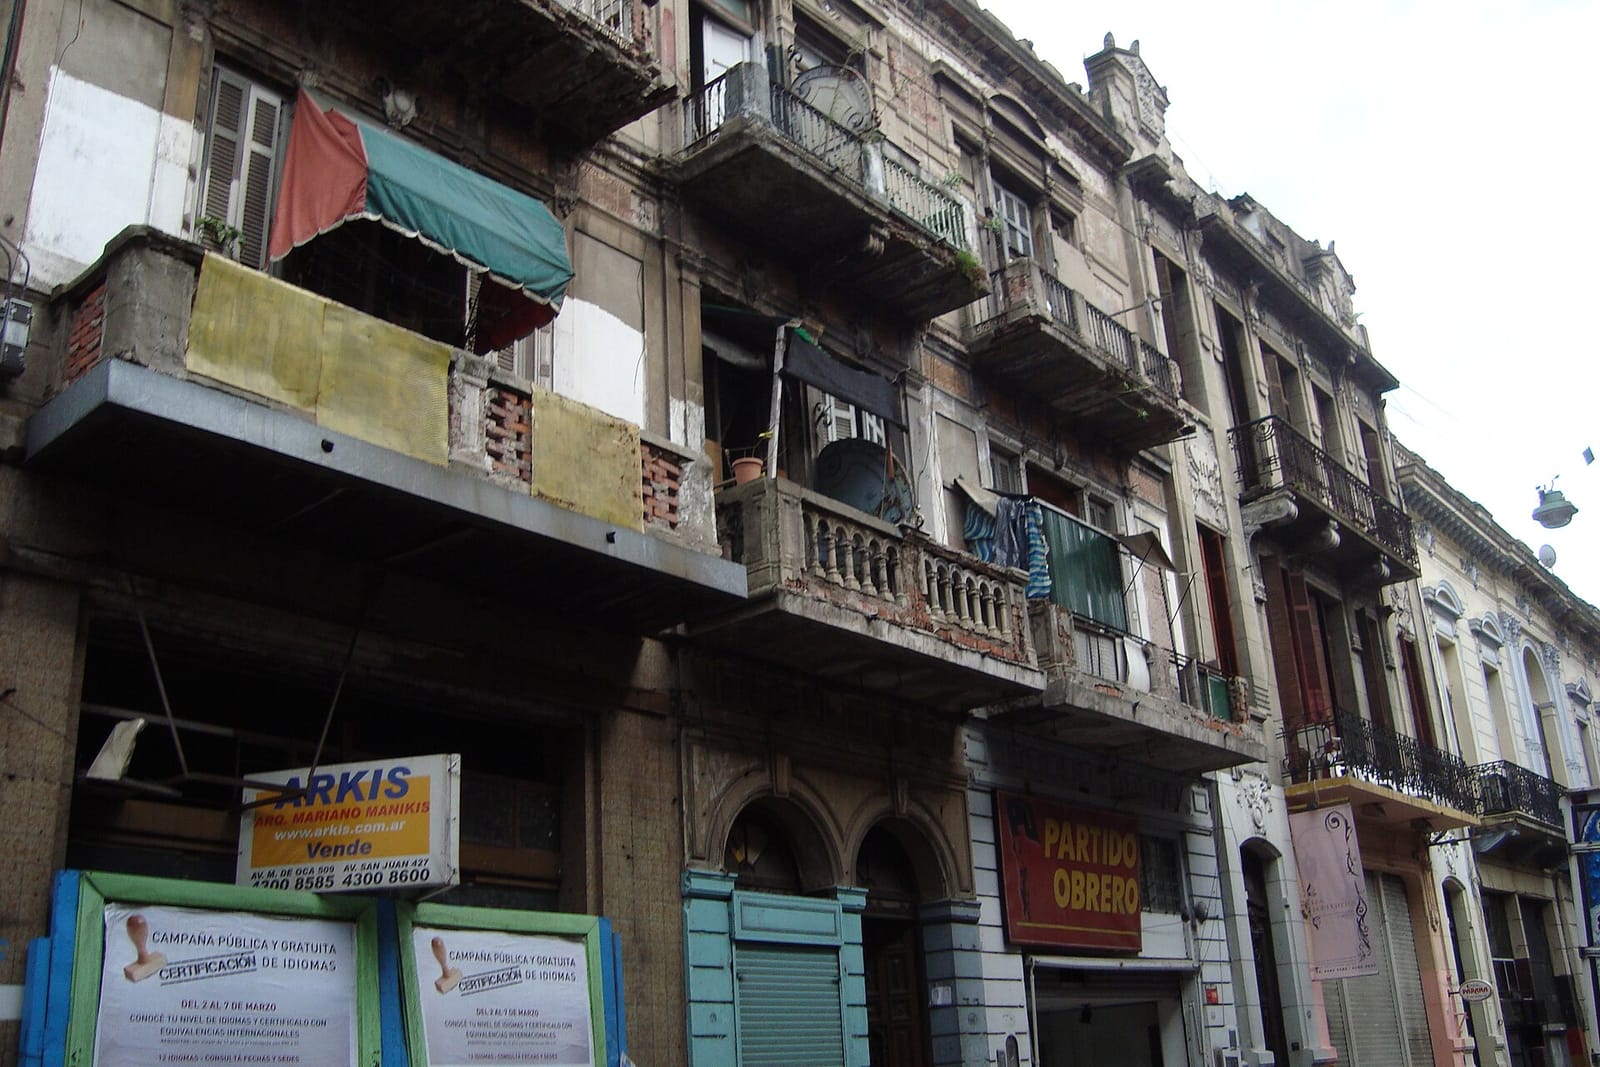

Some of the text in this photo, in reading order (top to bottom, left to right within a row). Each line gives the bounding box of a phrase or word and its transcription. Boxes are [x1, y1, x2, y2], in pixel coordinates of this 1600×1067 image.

[275, 766, 411, 810] ARKIS
[292, 807, 361, 824] MARIANO
[366, 801, 430, 817] MANIKIS
[275, 820, 406, 841] www.arkis.com.ar
[307, 839, 372, 859] Vende
[1044, 818, 1137, 868] PARTIDO
[280, 868, 293, 877] DE
[361, 862, 380, 871] SAN
[383, 860, 409, 870] JUAN
[294, 875, 335, 890] 8585
[342, 868, 430, 887] 4300 8600
[1054, 868, 1139, 915] OBRERO
[152, 931, 337, 955] CAMPAÑA PÚBLICA Y GRATUITA
[159, 952, 337, 980] CERTIFICACIÓN DE IDIOMAS
[449, 949, 493, 961] CAMPAÑA
[536, 955, 576, 967] GRATUITA
[458, 967, 576, 992] CERTIFICACIÓN DE IDIOMAS
[181, 999, 198, 1009] DEL
[209, 1000, 220, 1009] AL
[231, 1001, 242, 1010] DE
[245, 1002, 277, 1011] MARZO
[219, 1016, 252, 1026] IDIOMAS
